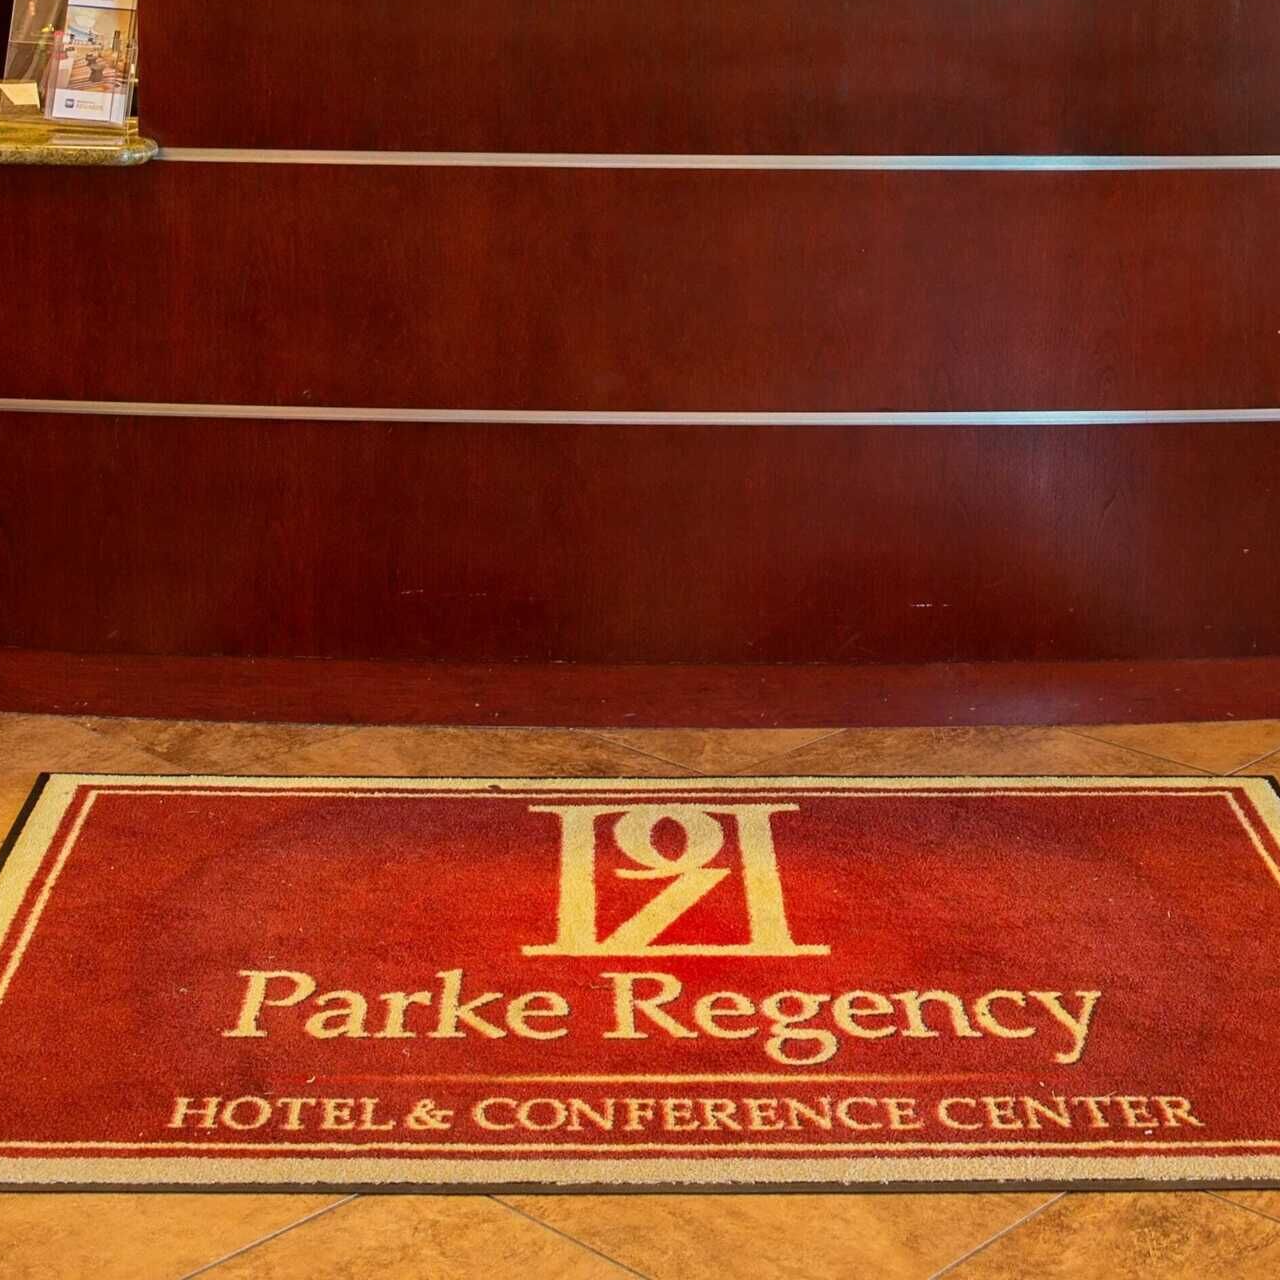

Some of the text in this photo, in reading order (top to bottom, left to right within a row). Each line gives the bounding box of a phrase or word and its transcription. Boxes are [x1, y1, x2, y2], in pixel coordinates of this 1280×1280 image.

[220, 967, 1103, 1066] Parke Regency
[168, 1094, 1206, 1132] HOTEL & CONFERENCE CENTER
